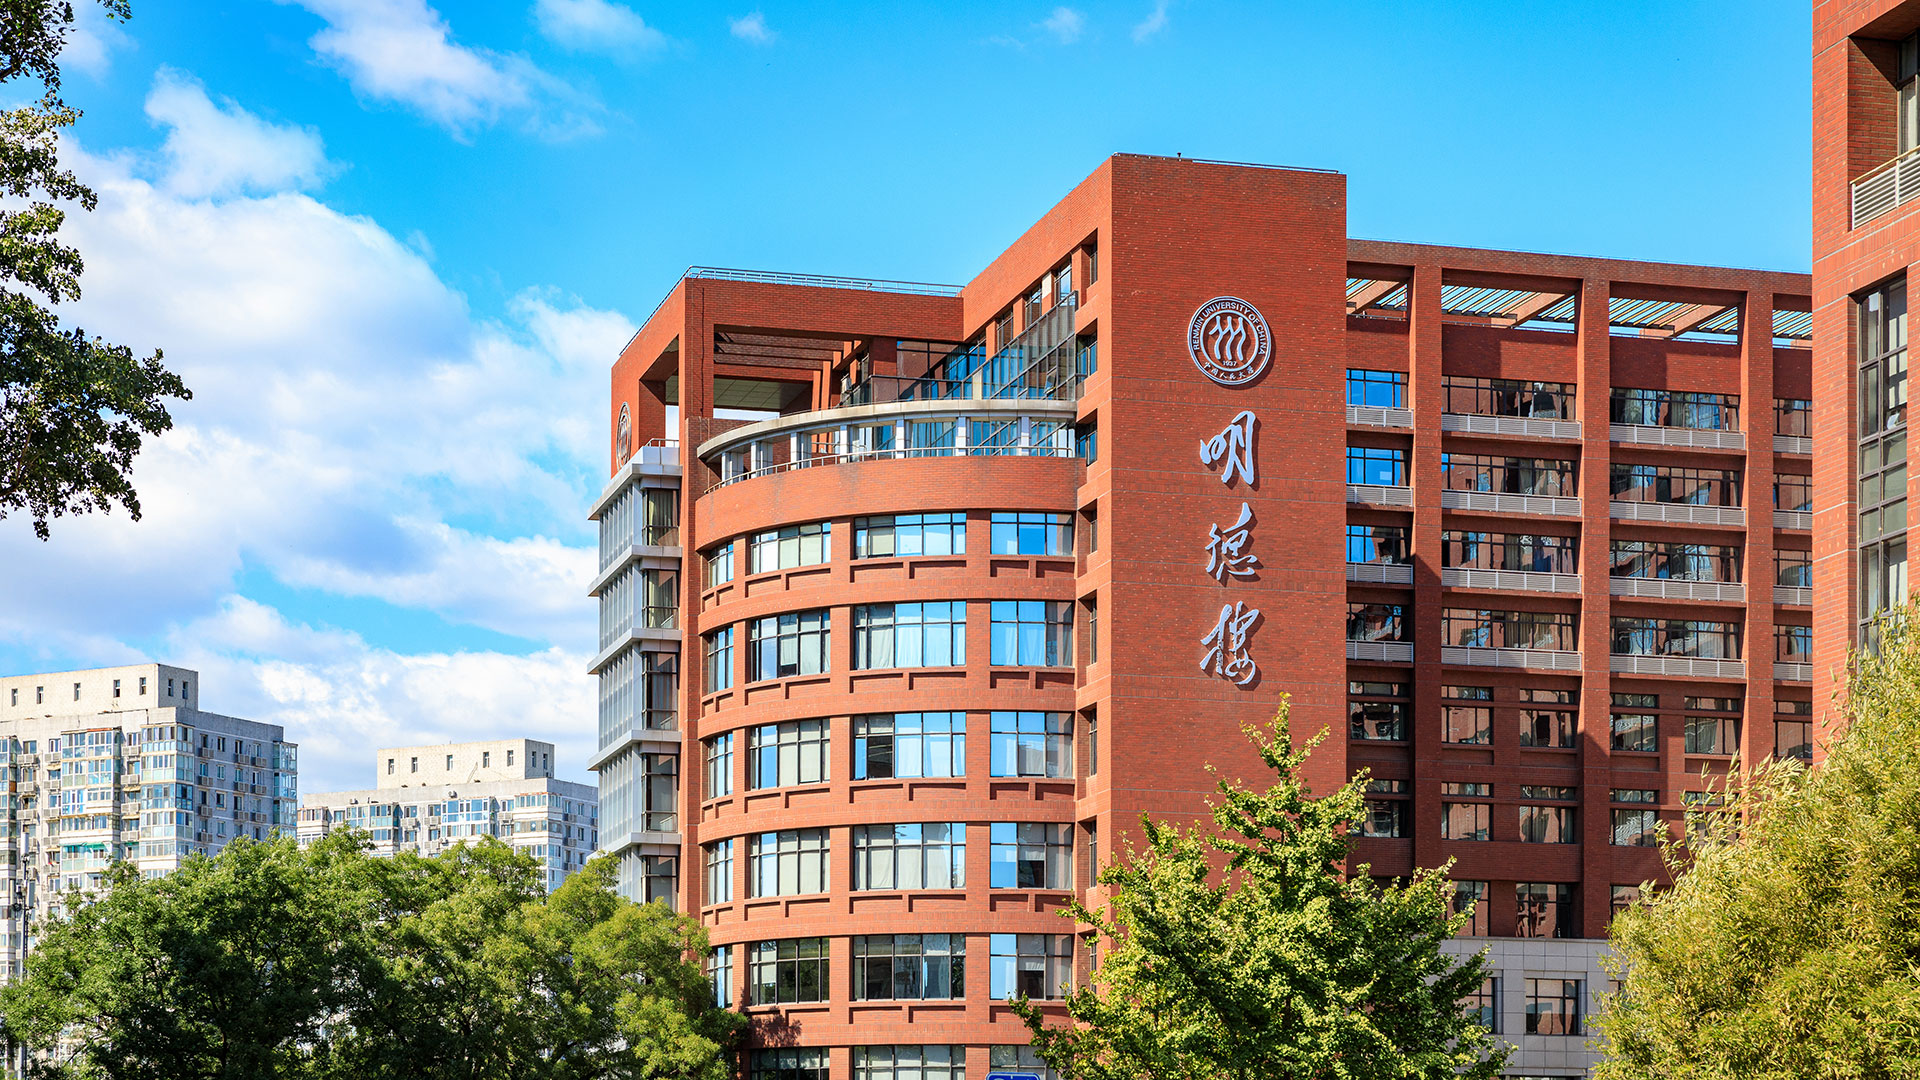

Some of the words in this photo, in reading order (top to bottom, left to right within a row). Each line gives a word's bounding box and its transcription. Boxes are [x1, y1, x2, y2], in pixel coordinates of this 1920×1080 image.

[1192, 316, 1204, 350] RENMIN
[1202, 301, 1251, 317] UNIVERSITY
[1248, 313, 1259, 324] OF
[1256, 325, 1267, 355] CHINA
